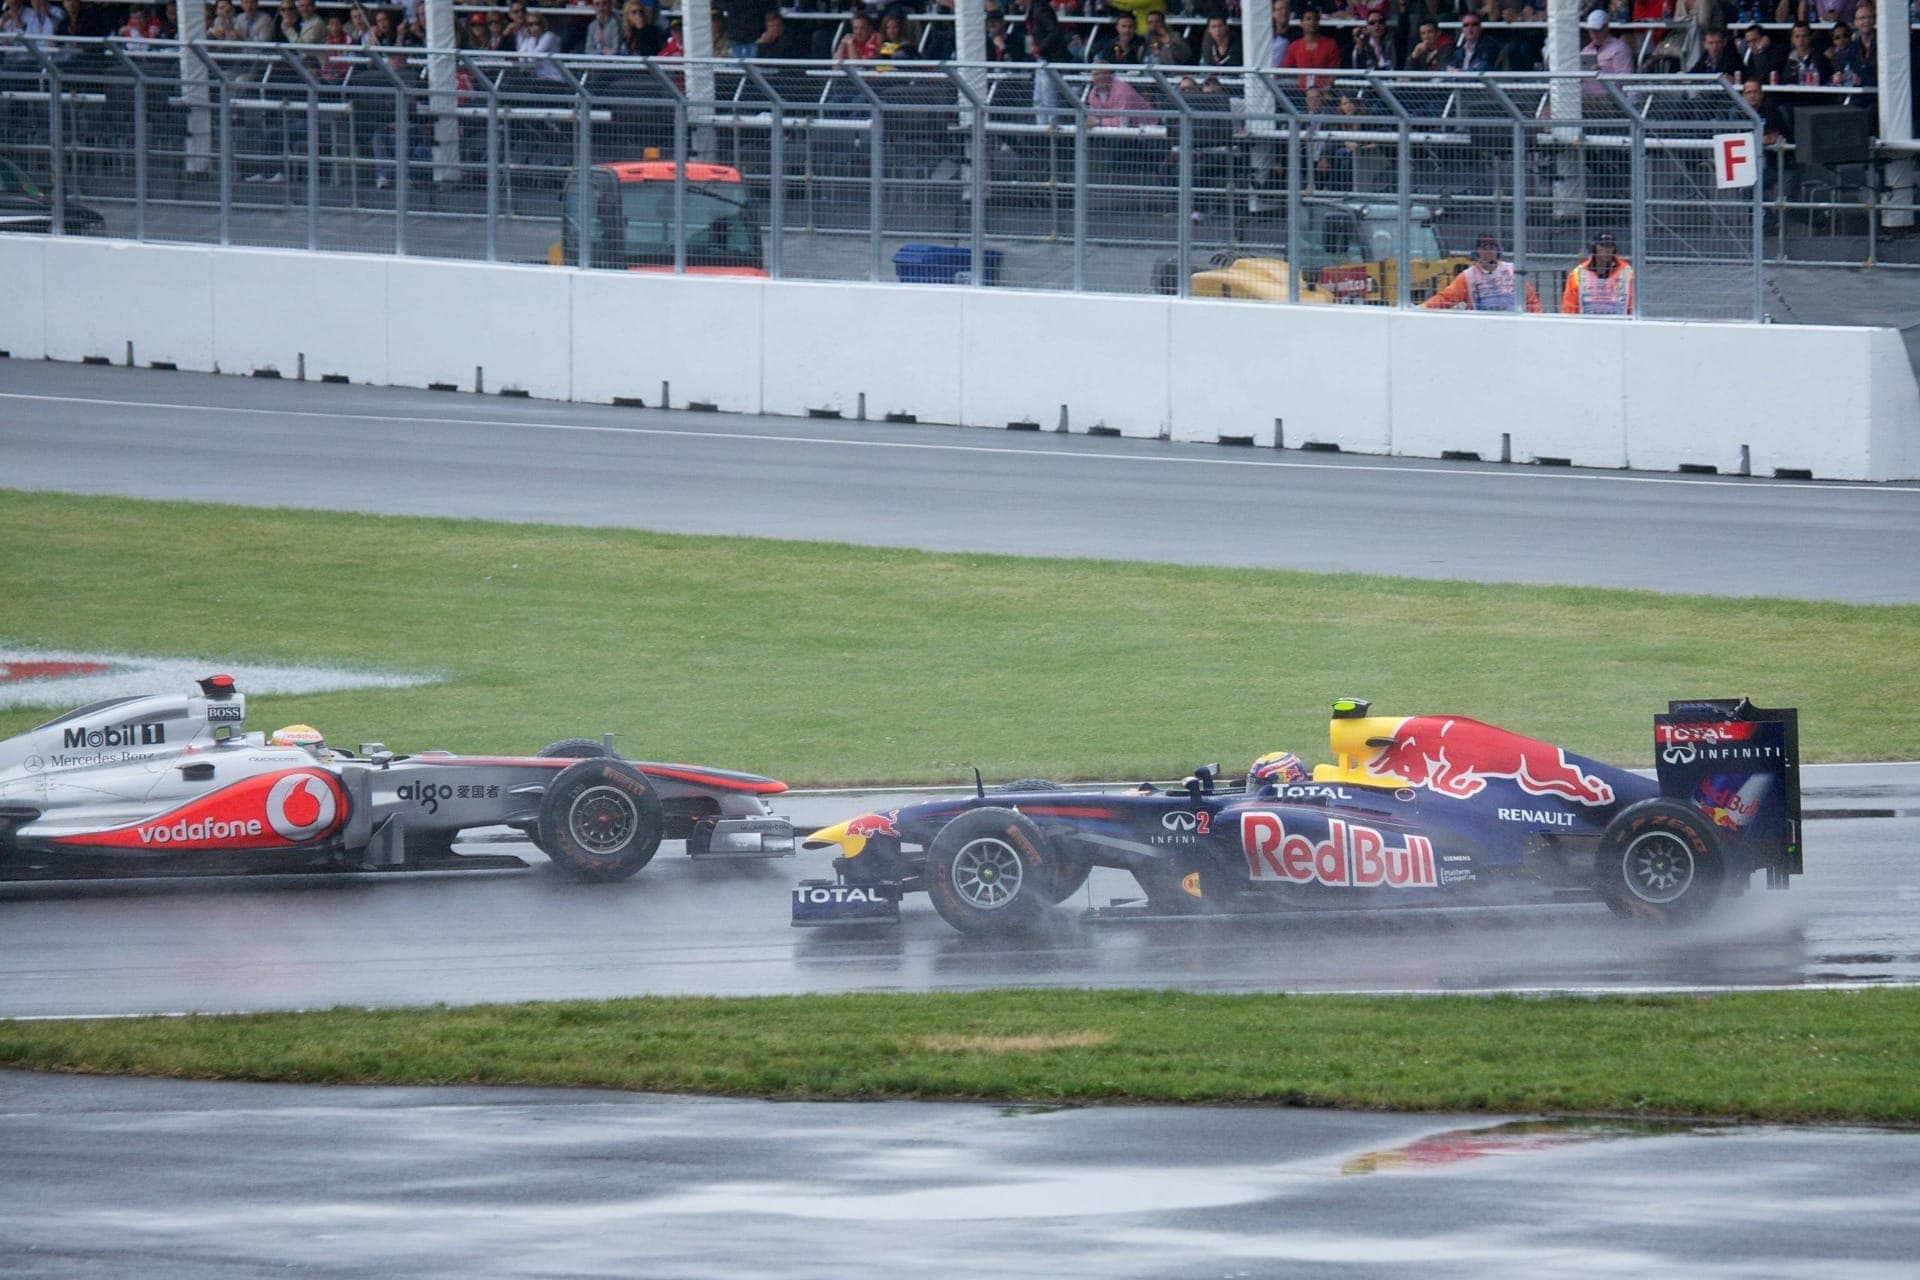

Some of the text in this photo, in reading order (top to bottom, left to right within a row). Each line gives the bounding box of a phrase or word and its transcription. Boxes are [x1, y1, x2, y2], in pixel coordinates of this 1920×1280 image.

[1723, 139, 1747, 182] F
[209, 708, 240, 717] BOSS
[64, 724, 161, 748] Mobil 1
[1660, 725, 1733, 740] TOTAL
[50, 751, 155, 768] Mercedes-Benz
[1700, 747, 1781, 760] INFINITI
[397, 780, 453, 815] aigo
[457, 784, 500, 799] 爱国者
[1271, 783, 1353, 800] TOTAL
[1196, 811, 1210, 834] 2
[1497, 807, 1577, 826] RENAULT
[137, 816, 263, 844] vodafone
[1241, 811, 1438, 888] Red Bull
[791, 886, 888, 904] TOTAL
